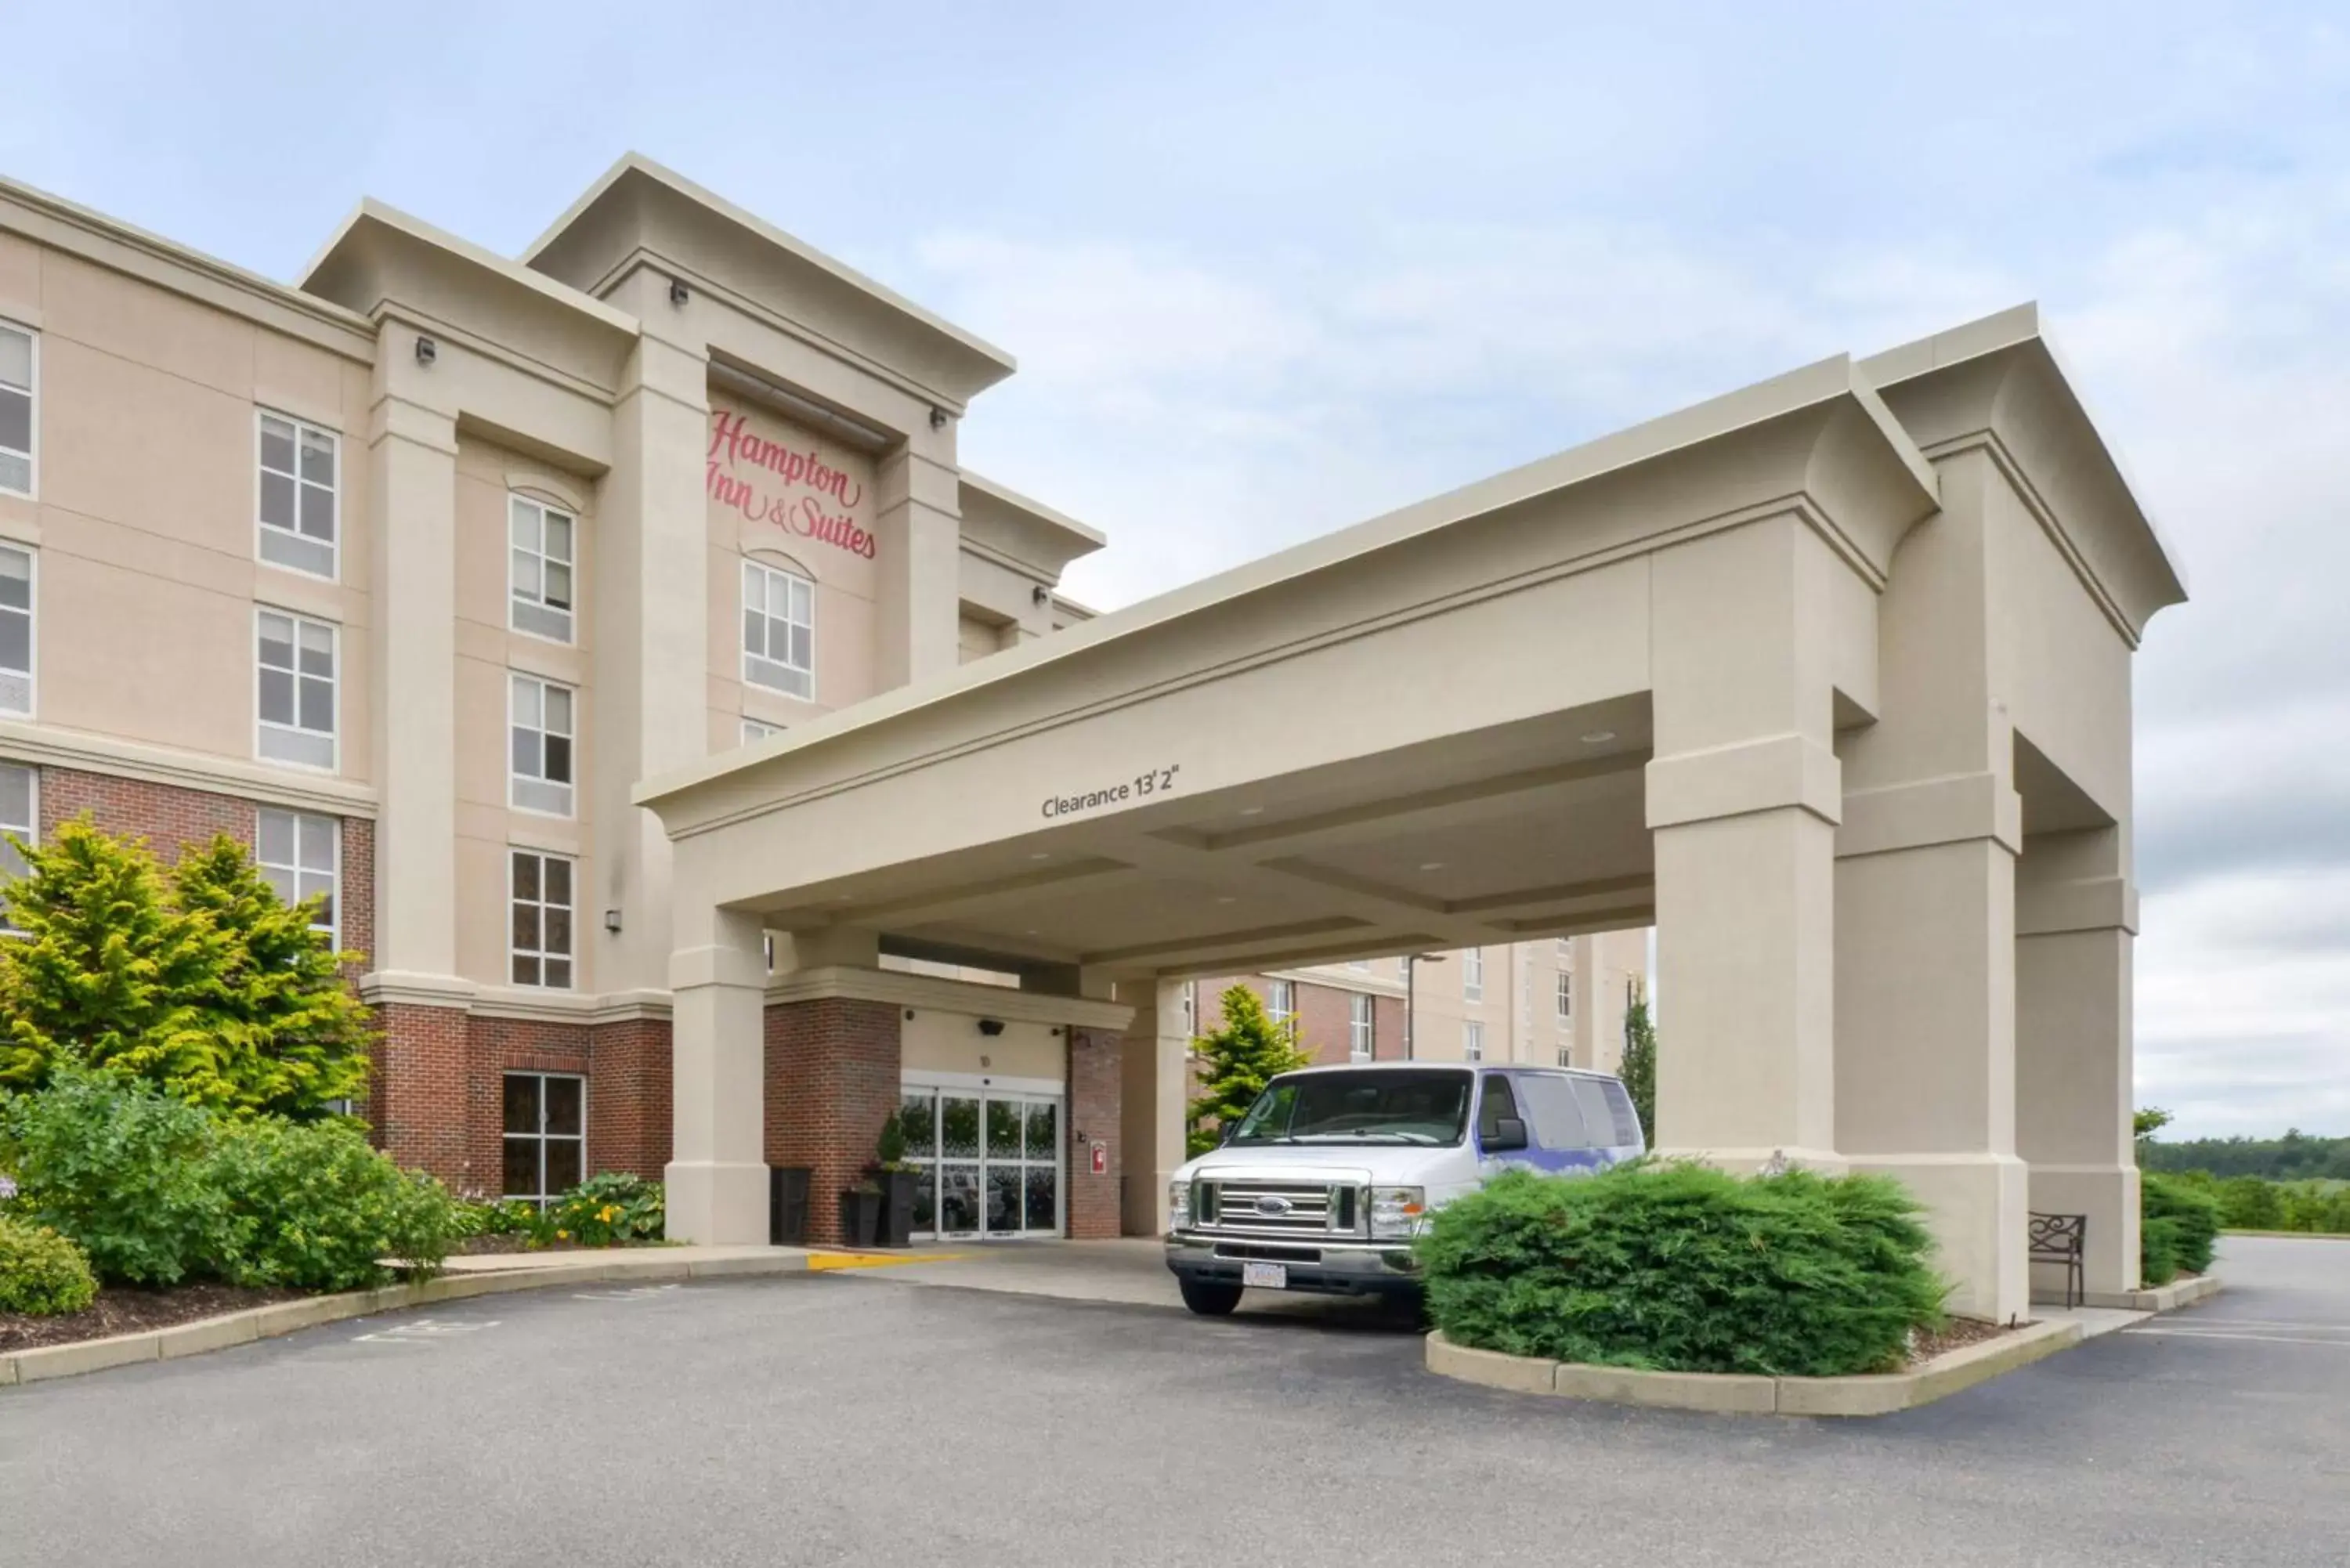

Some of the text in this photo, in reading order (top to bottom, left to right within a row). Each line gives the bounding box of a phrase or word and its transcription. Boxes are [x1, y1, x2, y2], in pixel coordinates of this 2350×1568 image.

[706, 410, 860, 508] Hampton
[768, 498, 790, 534] &
[789, 496, 876, 560] Suites
[1042, 784, 1129, 818] Clearance
